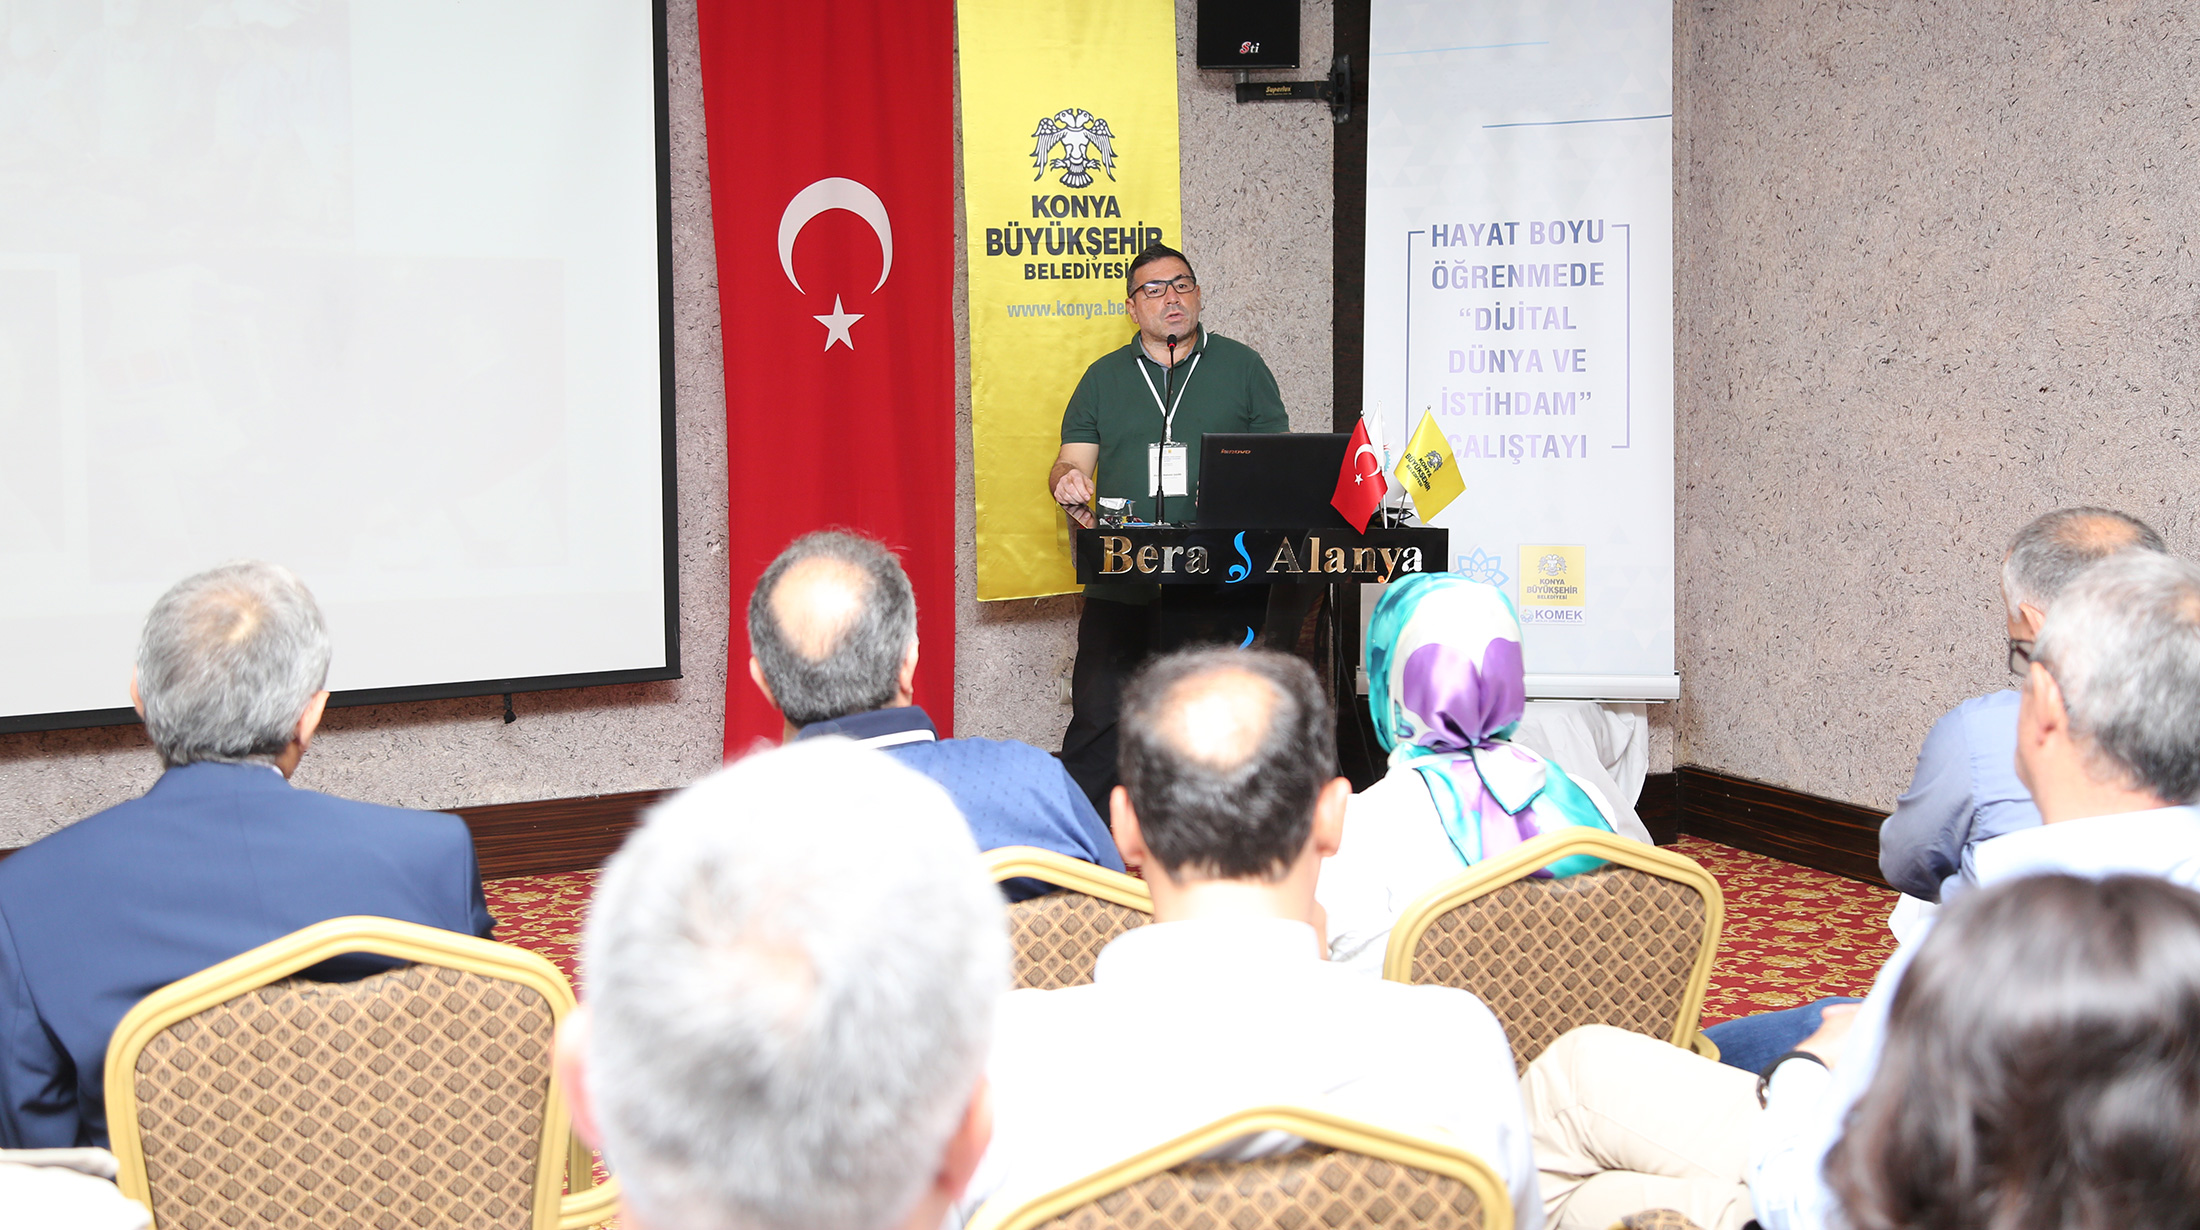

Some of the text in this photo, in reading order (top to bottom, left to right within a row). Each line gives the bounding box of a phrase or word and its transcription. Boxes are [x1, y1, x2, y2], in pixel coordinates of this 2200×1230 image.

[1239, 41, 1260, 54] Sti
[1031, 194, 1121, 218] KONYA
[985, 221, 1163, 260] BÜYÜKŞEHİR
[1431, 219, 1604, 247] HAYAT BOYU
[1024, 258, 1129, 280] BELEDİYESİ
[1431, 259, 1604, 289] ÖĞRENMEDE
[1007, 299, 1129, 319] www.konya.be
[1459, 301, 1576, 331] “DİJİTAL
[1449, 344, 1587, 373] DÜNYA VE
[1441, 386, 1592, 416] İSTİHDAM”
[1098, 535, 1424, 583] Bera Alanya
[1539, 578, 1565, 586] KONYA
[1535, 609, 1583, 620] KOMEK
